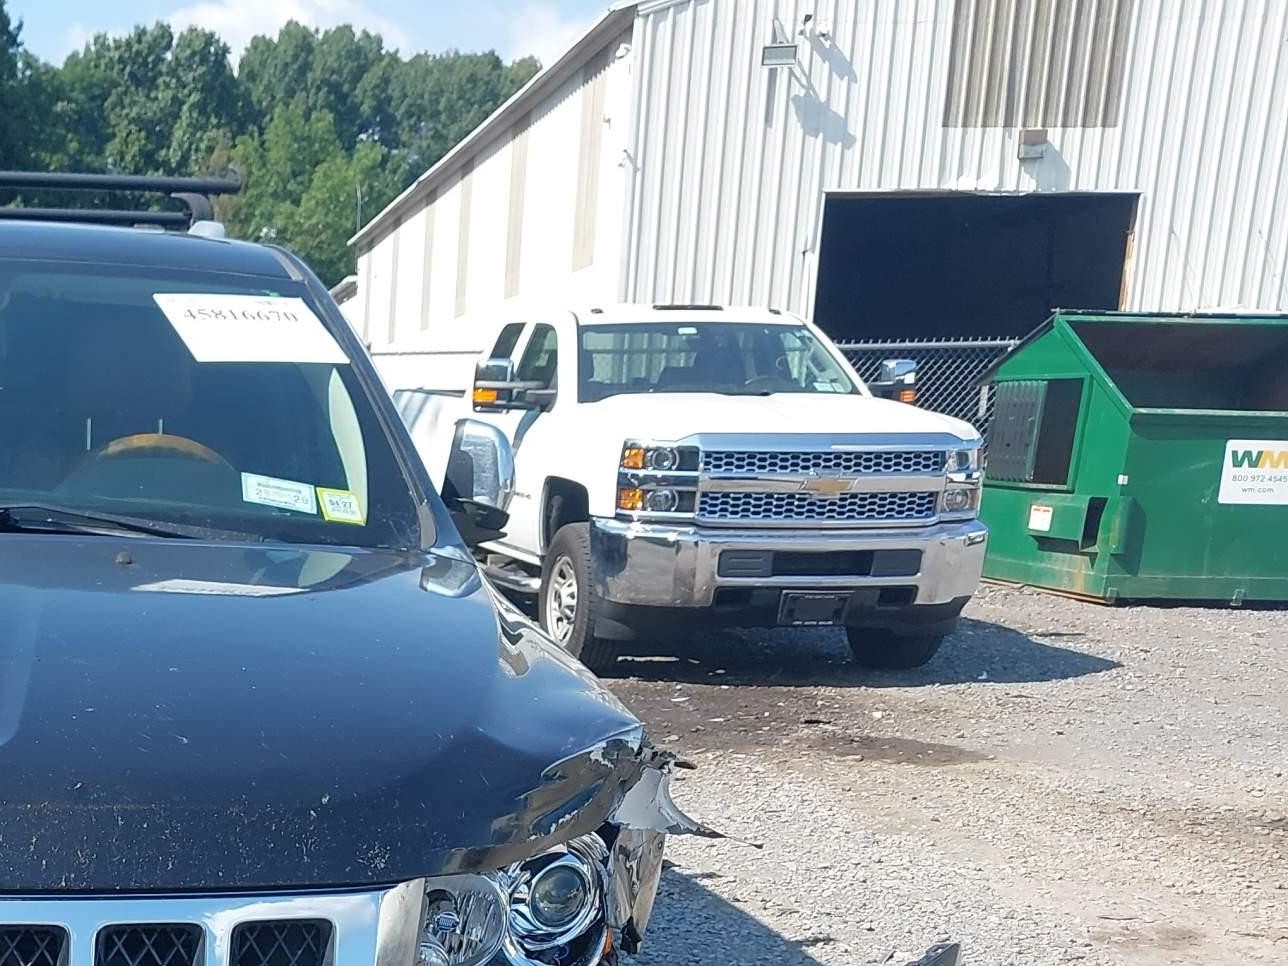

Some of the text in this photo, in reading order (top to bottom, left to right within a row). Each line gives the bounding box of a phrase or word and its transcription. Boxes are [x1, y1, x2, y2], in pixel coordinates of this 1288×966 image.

[1231, 449, 1288, 469] WM
[1231, 474, 1248, 482] 800
[1250, 474, 1266, 483] 972
